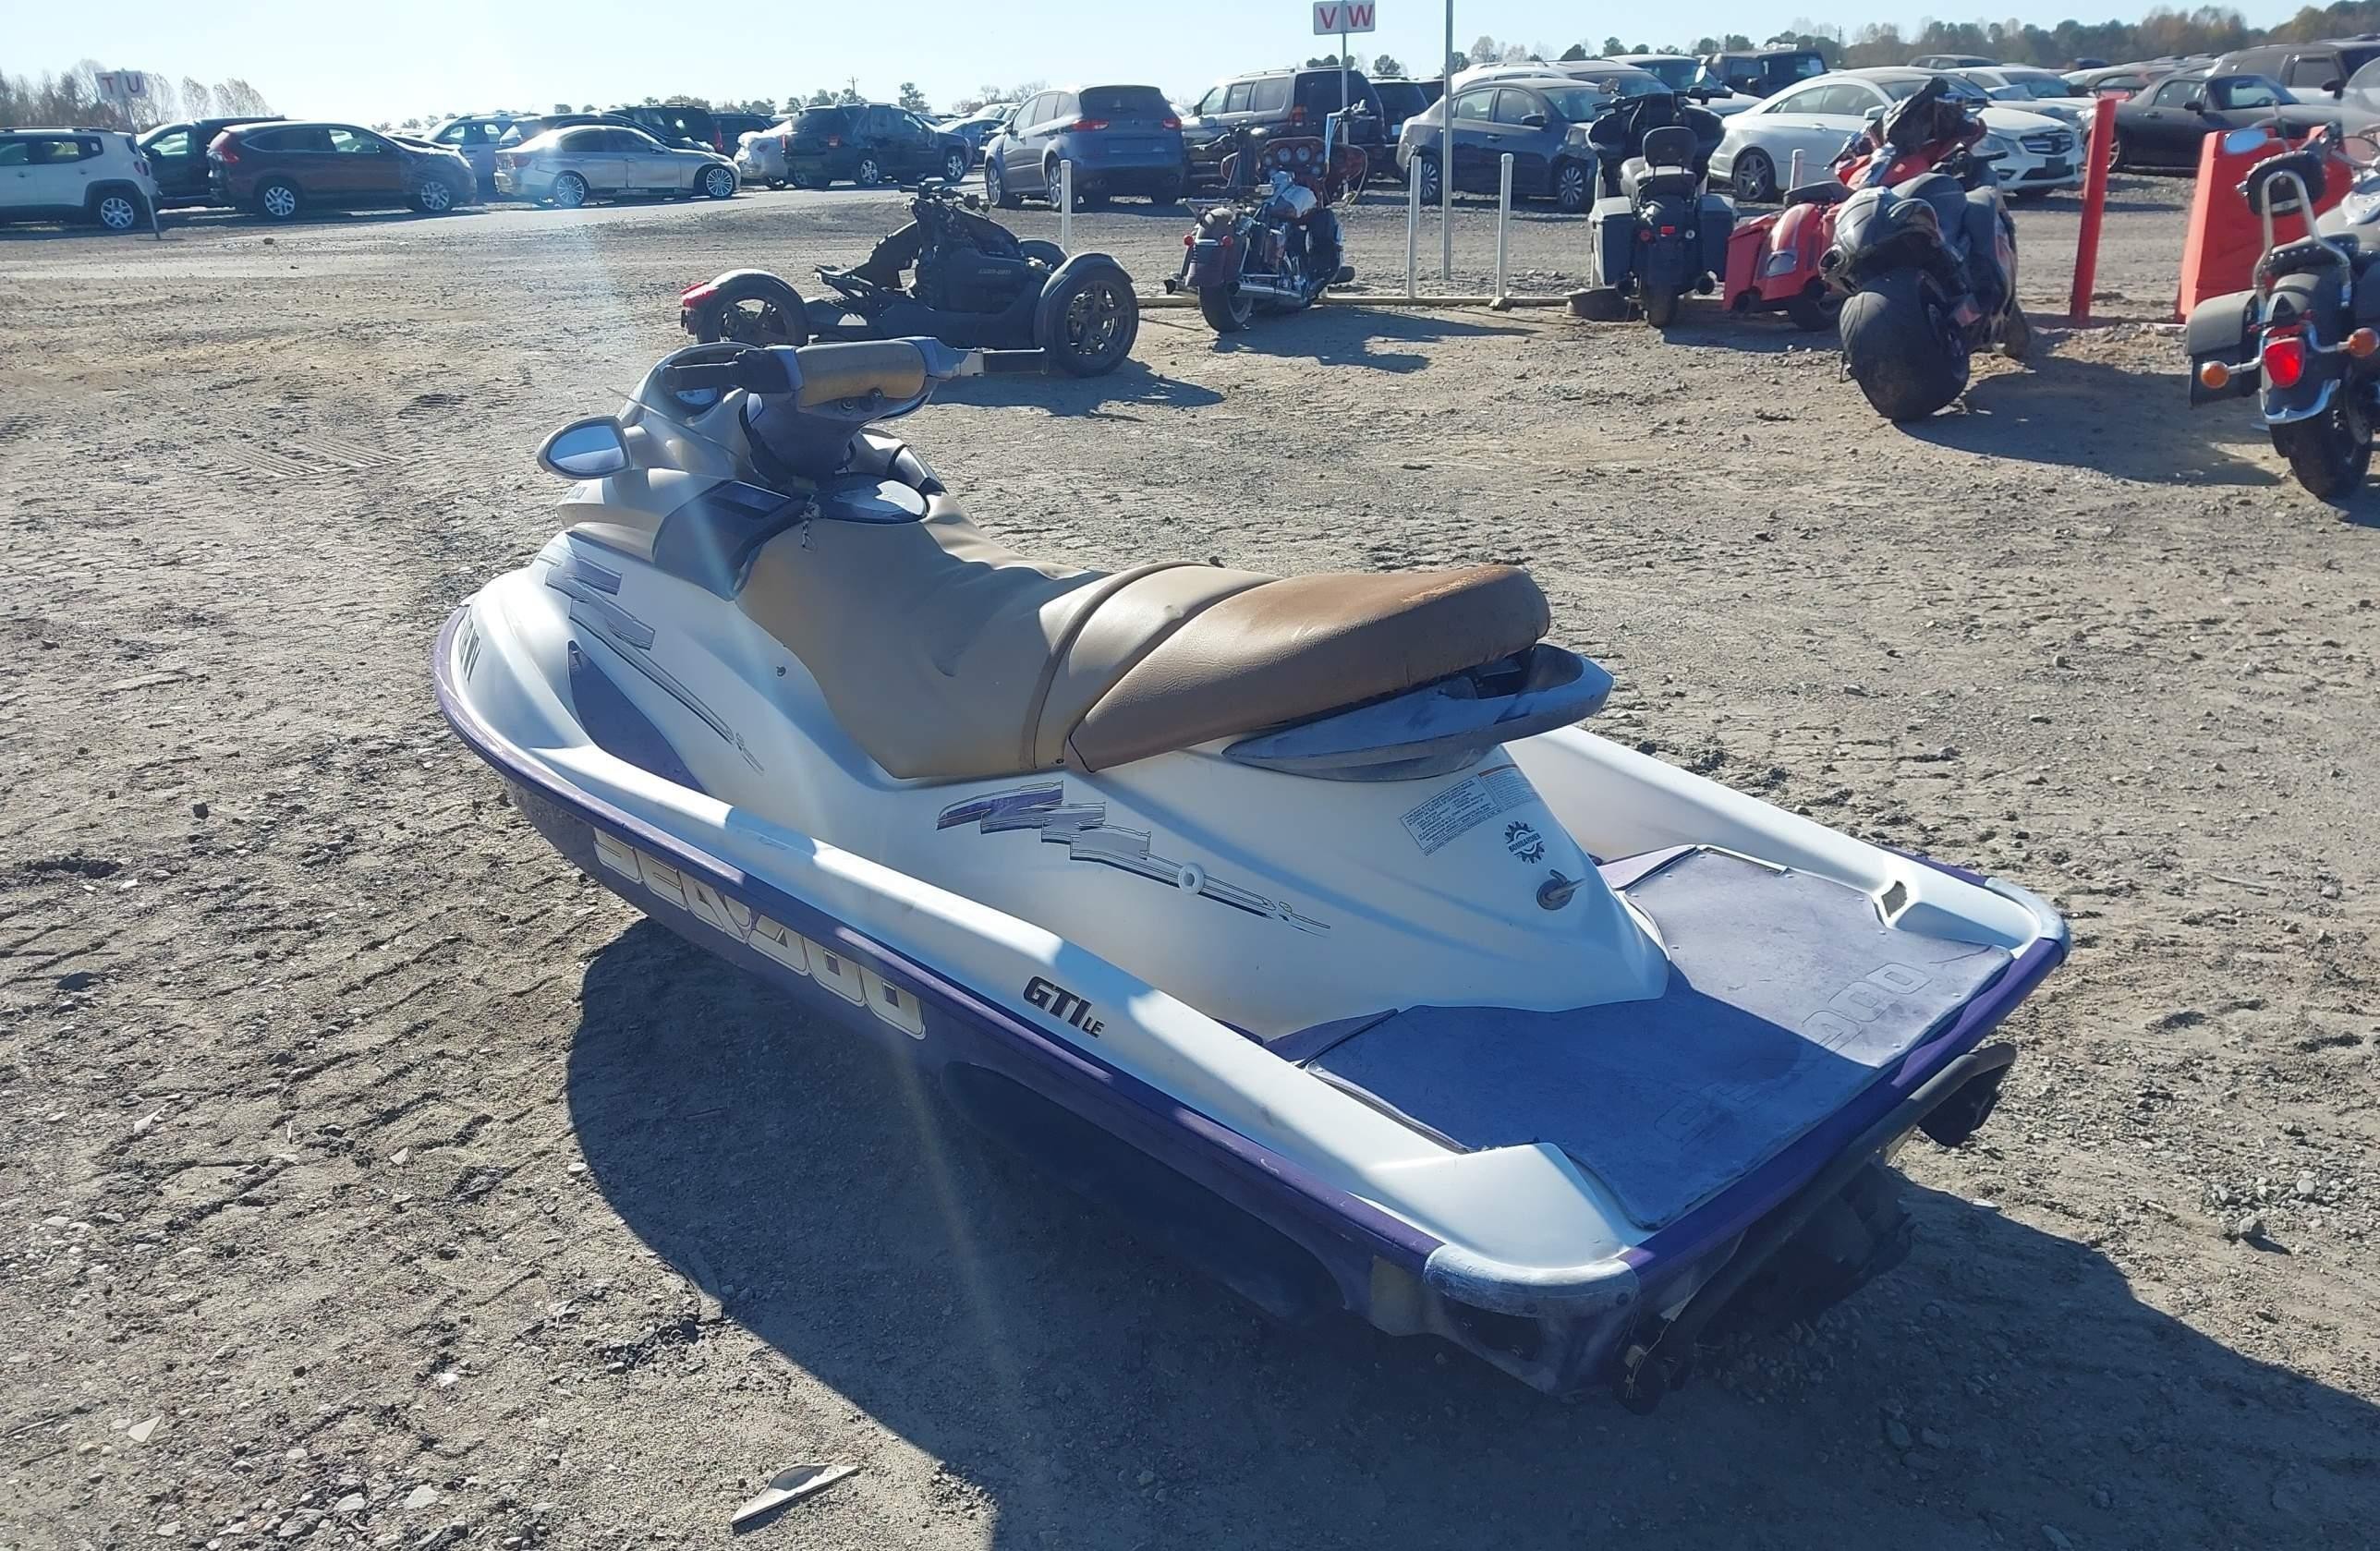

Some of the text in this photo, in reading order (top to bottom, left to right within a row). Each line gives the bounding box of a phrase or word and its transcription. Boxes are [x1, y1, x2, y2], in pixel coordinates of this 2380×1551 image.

[1319, 5, 1373, 29] V W
[102, 76, 140, 94] T U
[1082, 1016, 1105, 1038] LE
